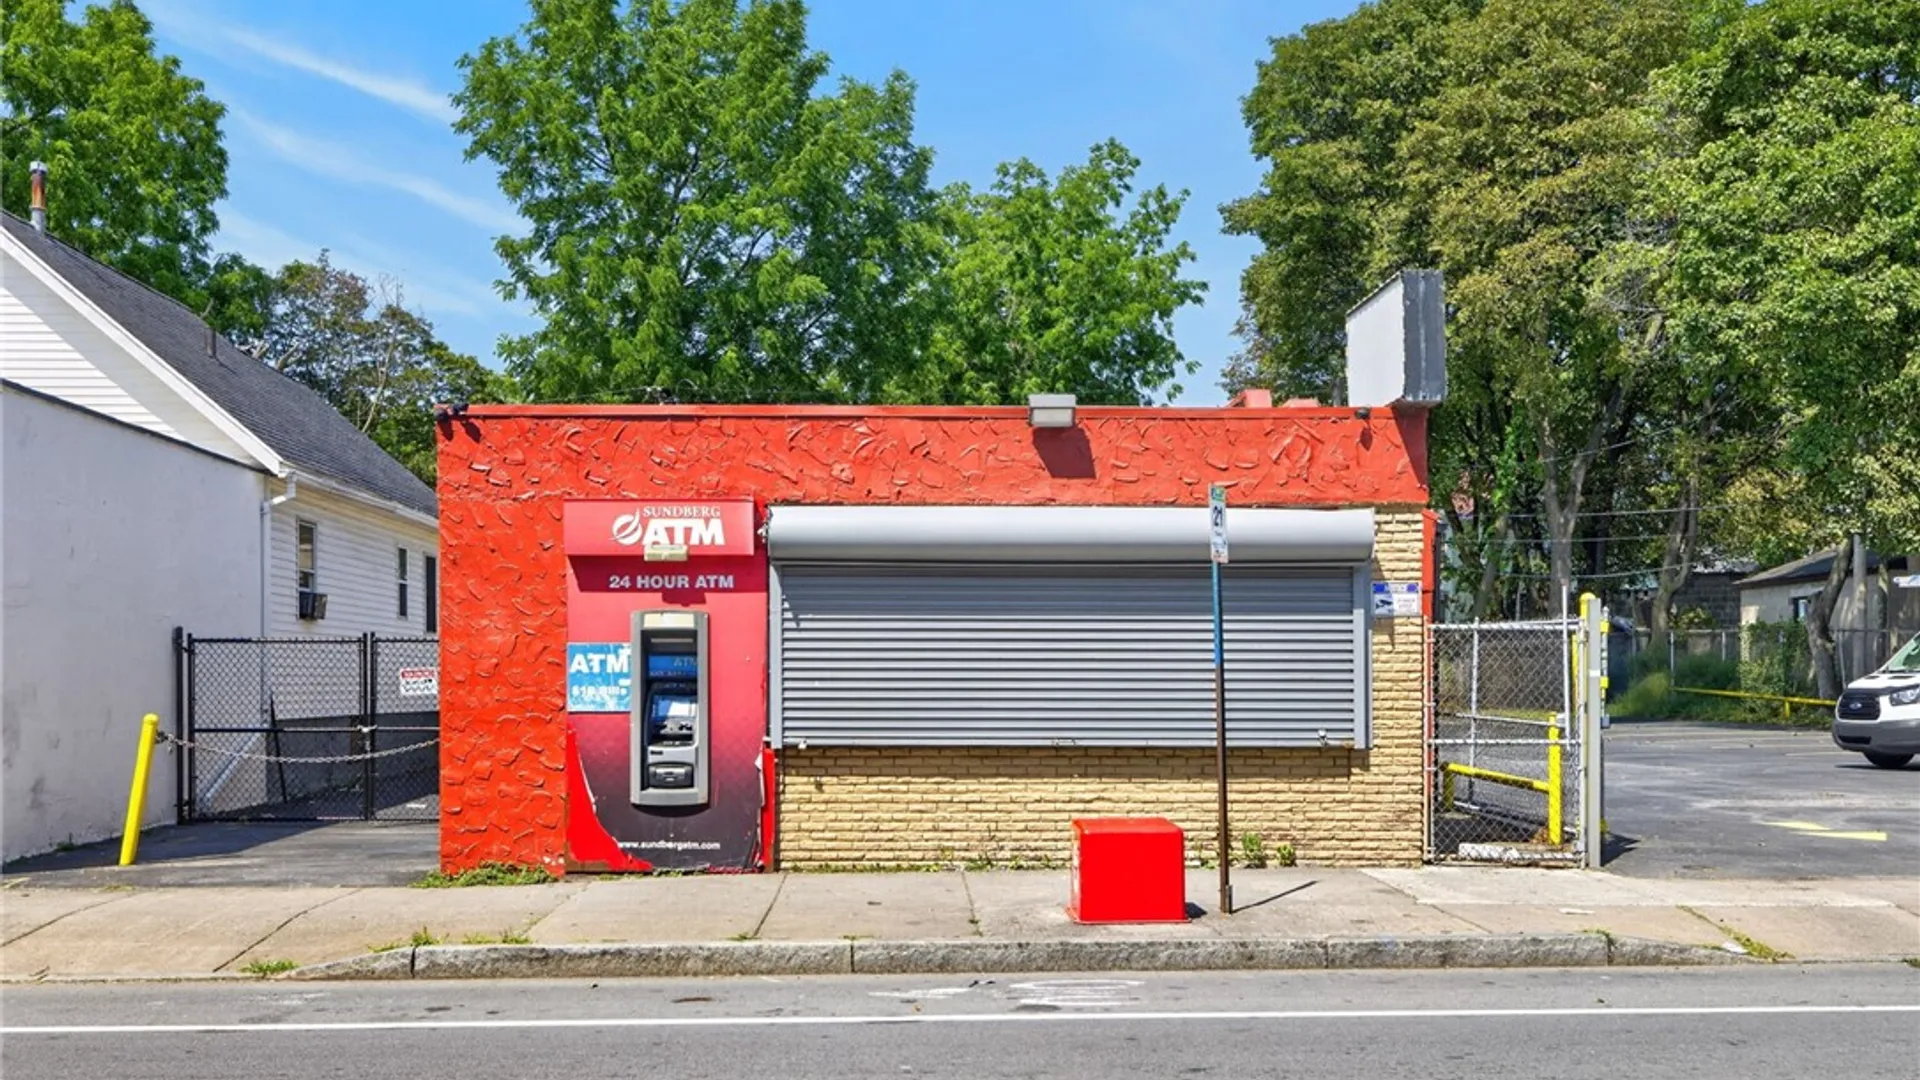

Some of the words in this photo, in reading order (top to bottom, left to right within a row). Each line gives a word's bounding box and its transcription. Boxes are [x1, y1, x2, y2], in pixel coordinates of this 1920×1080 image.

[643, 505, 721, 518] SUNDBERG
[642, 518, 725, 546] ATM
[609, 575, 631, 589] 24
[636, 575, 690, 589] HOUR
[695, 575, 735, 589] ATM
[569, 653, 629, 673] ATM
[617, 840, 721, 851] www.sundbergatm.com
